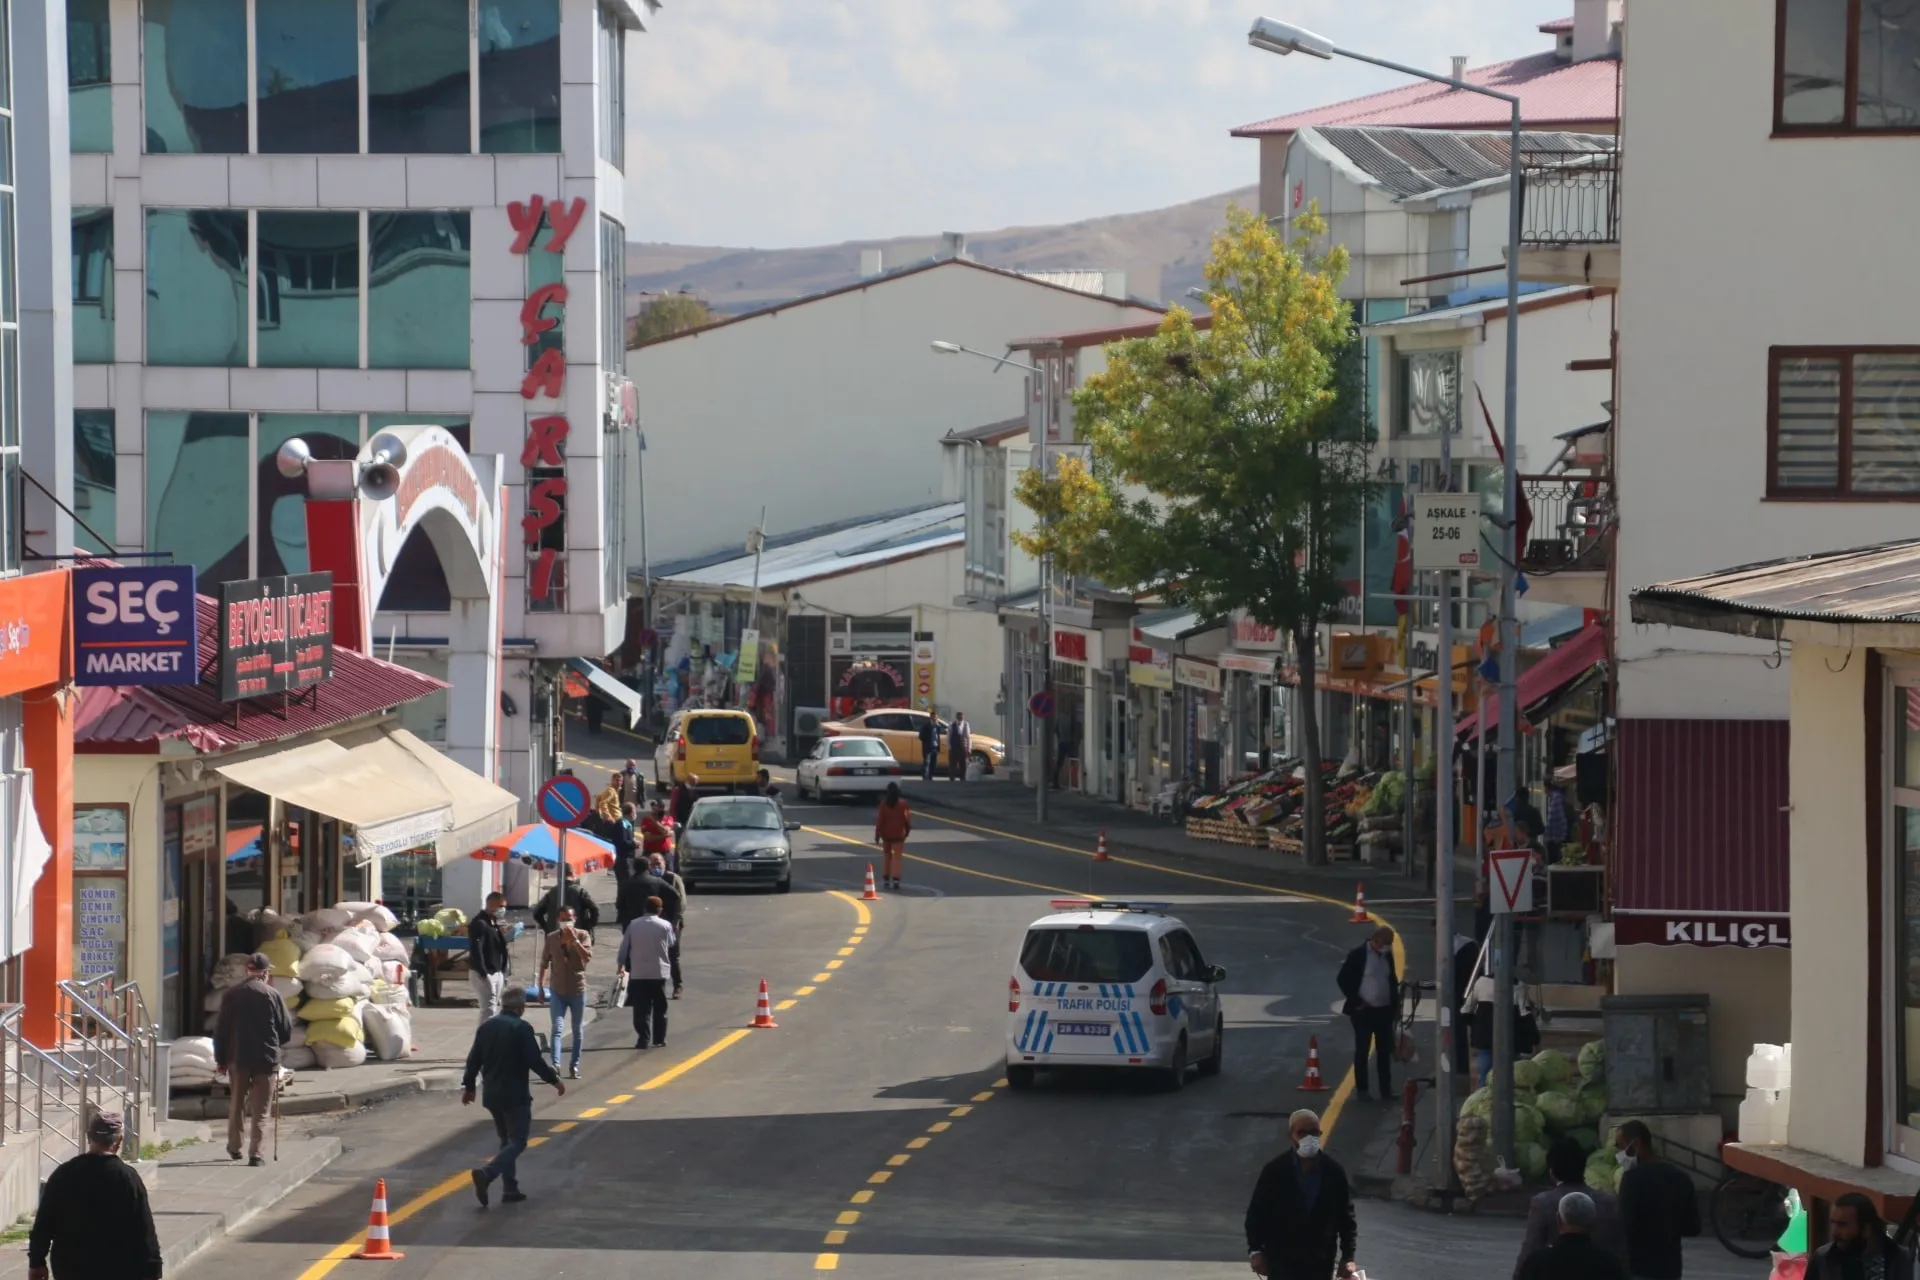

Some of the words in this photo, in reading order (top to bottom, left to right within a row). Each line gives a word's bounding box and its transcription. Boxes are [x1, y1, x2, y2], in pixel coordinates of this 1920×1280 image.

[506, 193, 587, 254] YY
[519, 282, 570, 600] ÇARŞI
[1427, 508, 1466, 521] AŞKALE
[1432, 527, 1461, 540] 25-06
[86, 580, 180, 635] SEÇ
[229, 585, 286, 649] BEYOĞLU
[288, 583, 331, 639] TİCARET
[86, 651, 182, 674] MARKET
[1666, 921, 1791, 947] KILIÇL
